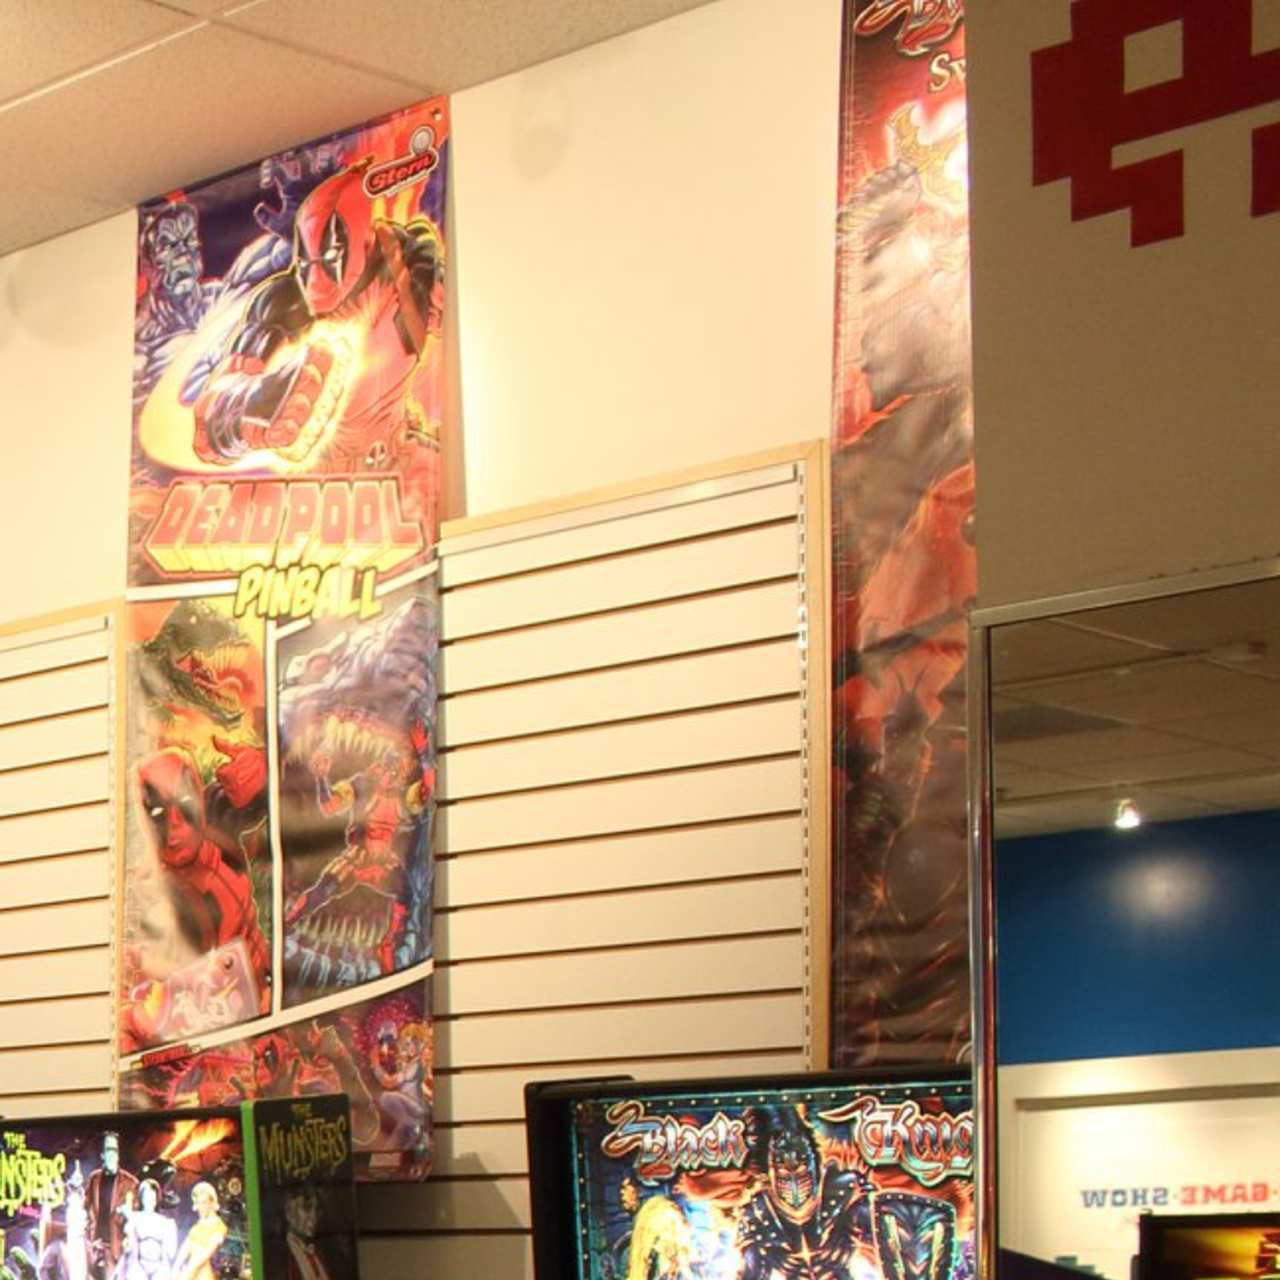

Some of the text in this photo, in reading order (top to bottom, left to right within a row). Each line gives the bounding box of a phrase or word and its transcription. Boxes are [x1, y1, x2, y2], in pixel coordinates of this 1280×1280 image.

[146, 479, 428, 570] DEADPOOL
[233, 565, 383, 619] PINBALL
[3, 1131, 27, 1149] THE
[258, 1114, 348, 1182] MUNSTERS
[603, 1096, 975, 1185] Black Knig
